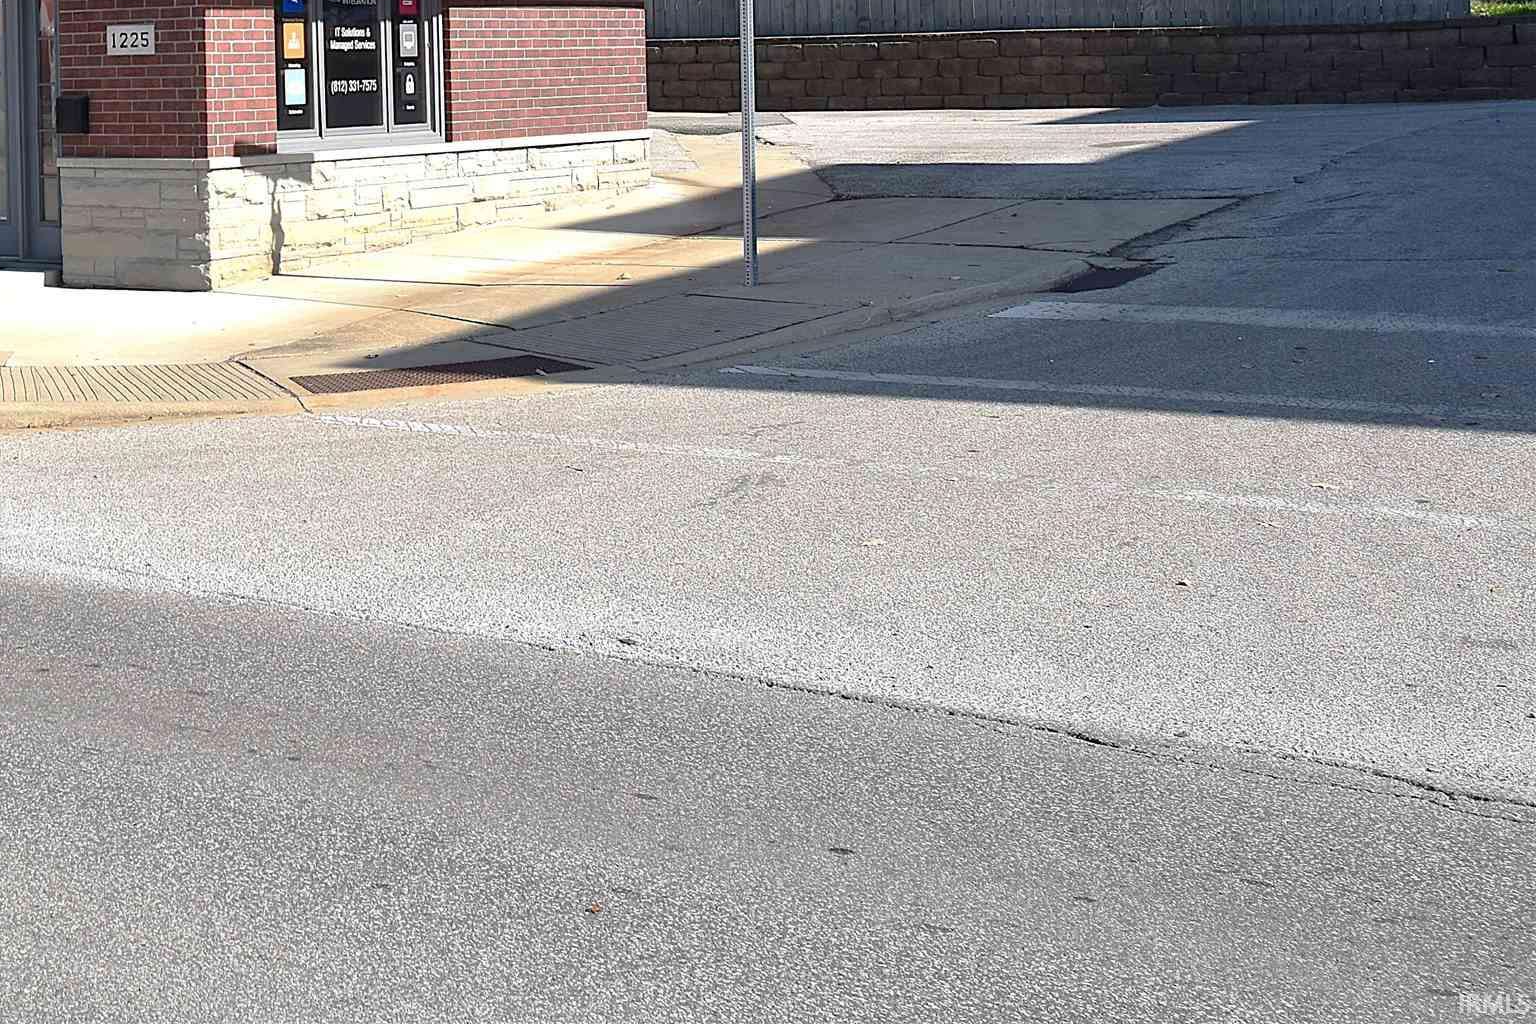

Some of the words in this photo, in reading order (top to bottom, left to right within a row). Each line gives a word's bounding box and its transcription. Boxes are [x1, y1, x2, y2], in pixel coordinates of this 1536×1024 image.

[334, 27, 340, 37] IT
[341, 27, 365, 37] Solutions
[112, 32, 149, 48] 1225
[330, 40, 354, 52] Managed
[355, 40, 376, 50] Services
[331, 80, 347, 94] (812)
[349, 80, 377, 93] 331-7575
